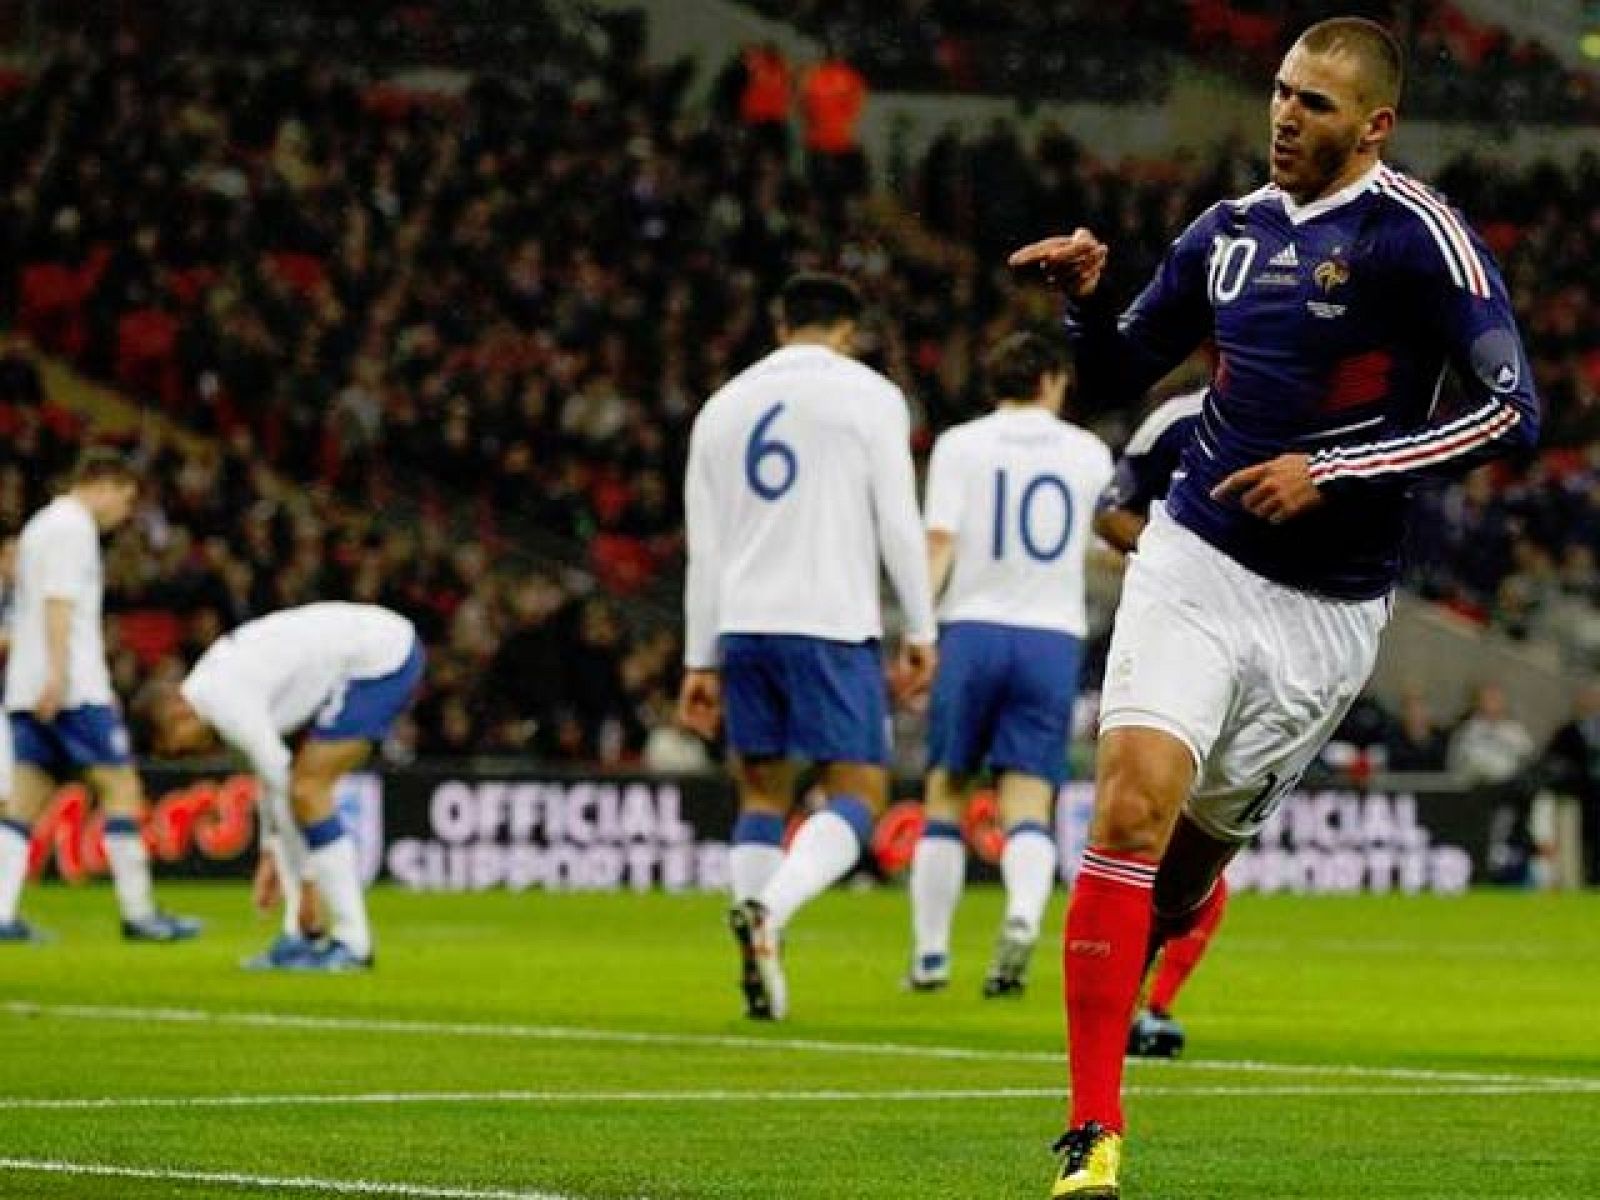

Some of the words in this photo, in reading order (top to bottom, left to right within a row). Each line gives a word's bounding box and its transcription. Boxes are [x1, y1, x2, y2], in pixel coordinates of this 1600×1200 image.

[1207, 235, 1259, 304] 10
[744, 400, 798, 502] 6
[991, 466, 1074, 562] 10
[430, 780, 694, 844] OFFICIAL
